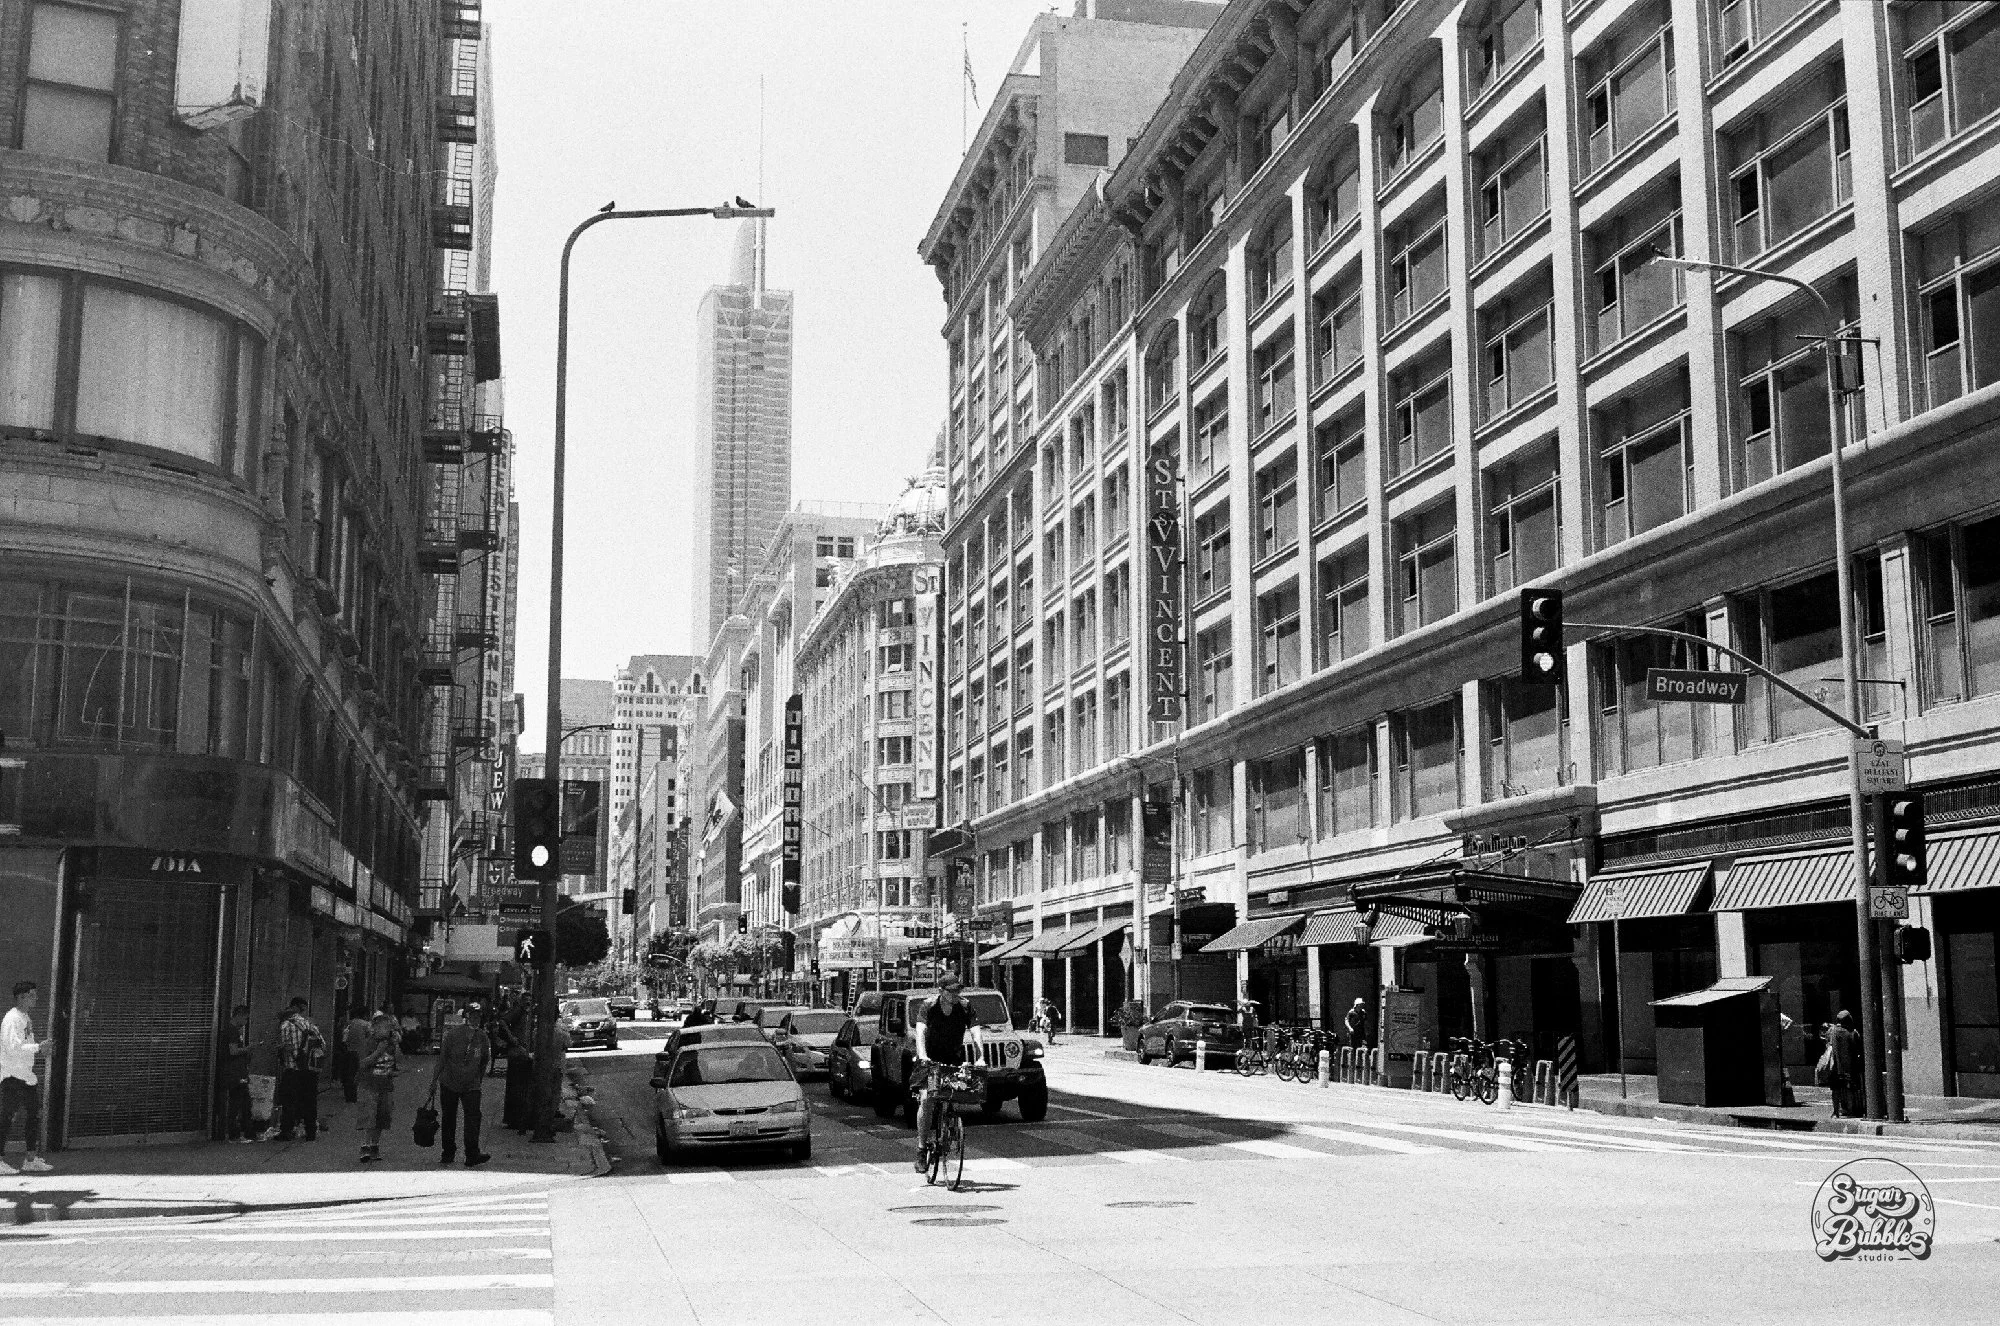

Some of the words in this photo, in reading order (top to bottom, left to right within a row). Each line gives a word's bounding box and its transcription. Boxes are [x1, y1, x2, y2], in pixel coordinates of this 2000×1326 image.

[1152, 546, 1176, 716] VINCENT
[916, 607, 935, 792] VINCENT
[1656, 676, 1739, 698] Broadway
[487, 750, 506, 884] JEWLRY
[1866, 777, 1898, 785] SQUARE
[481, 884, 523, 898] Broadway
